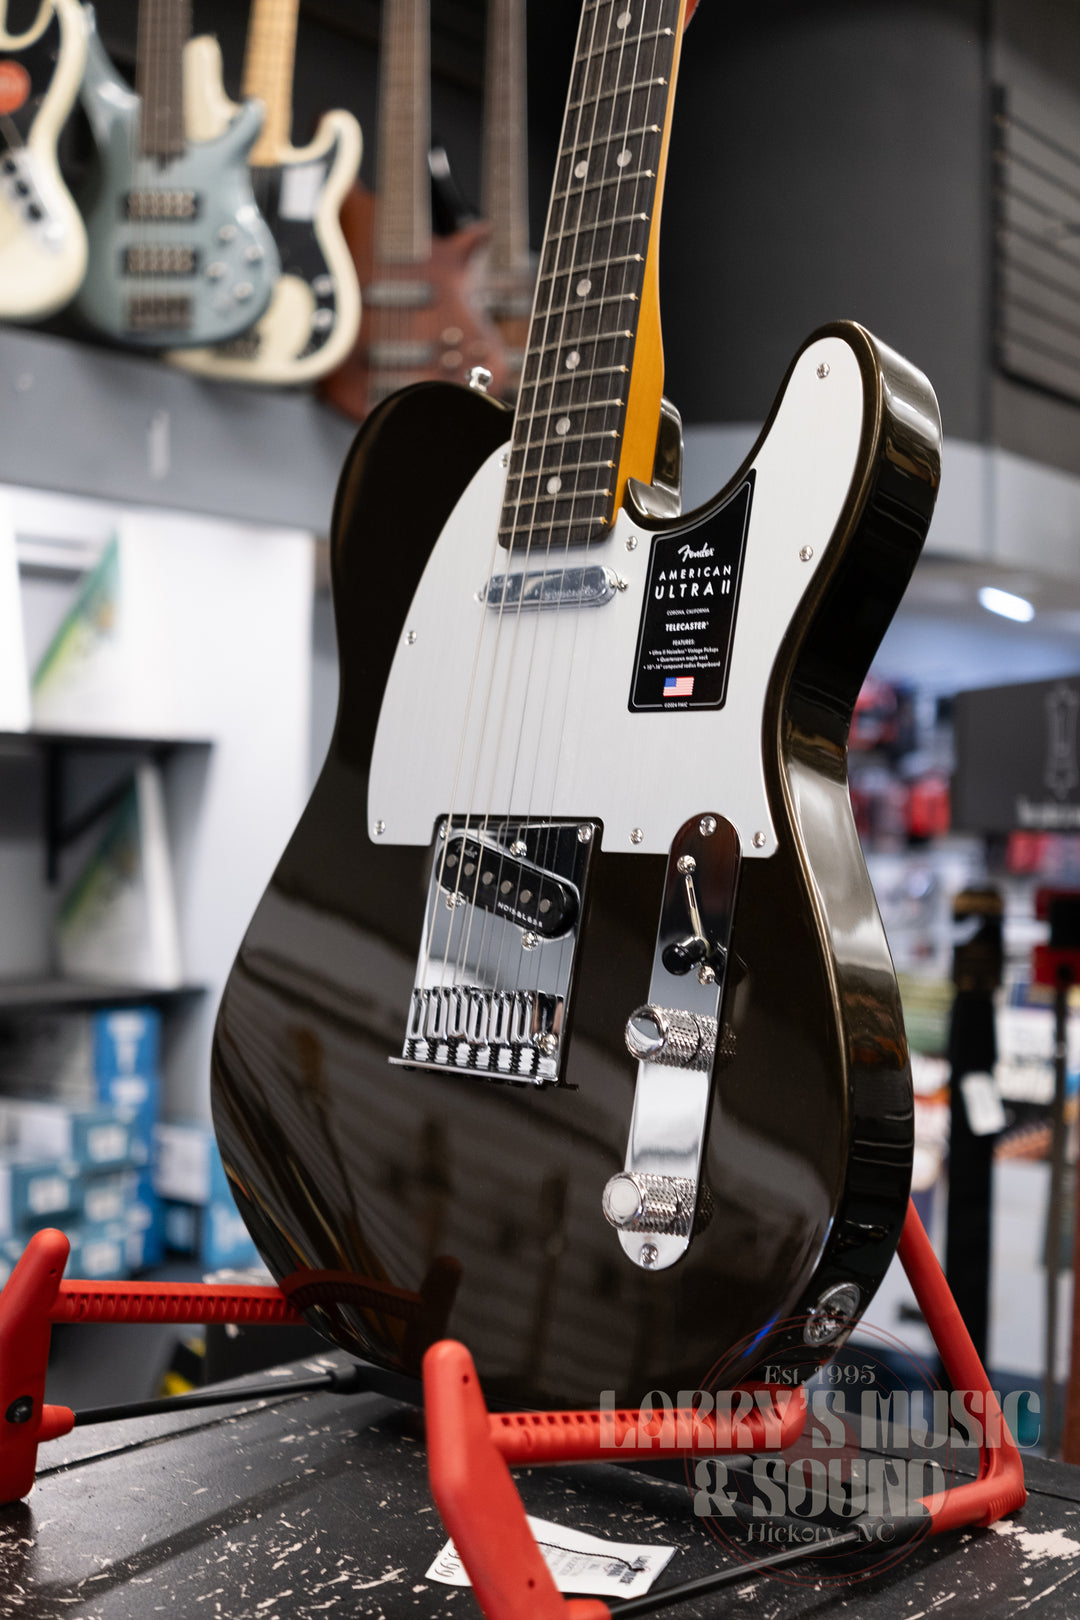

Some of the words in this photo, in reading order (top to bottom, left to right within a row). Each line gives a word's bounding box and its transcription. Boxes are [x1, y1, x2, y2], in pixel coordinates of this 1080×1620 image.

[677, 542, 715, 563] Fender
[658, 564, 732, 581] AMERICAN
[654, 581, 714, 600] ULTRA
[721, 579, 731, 595] II
